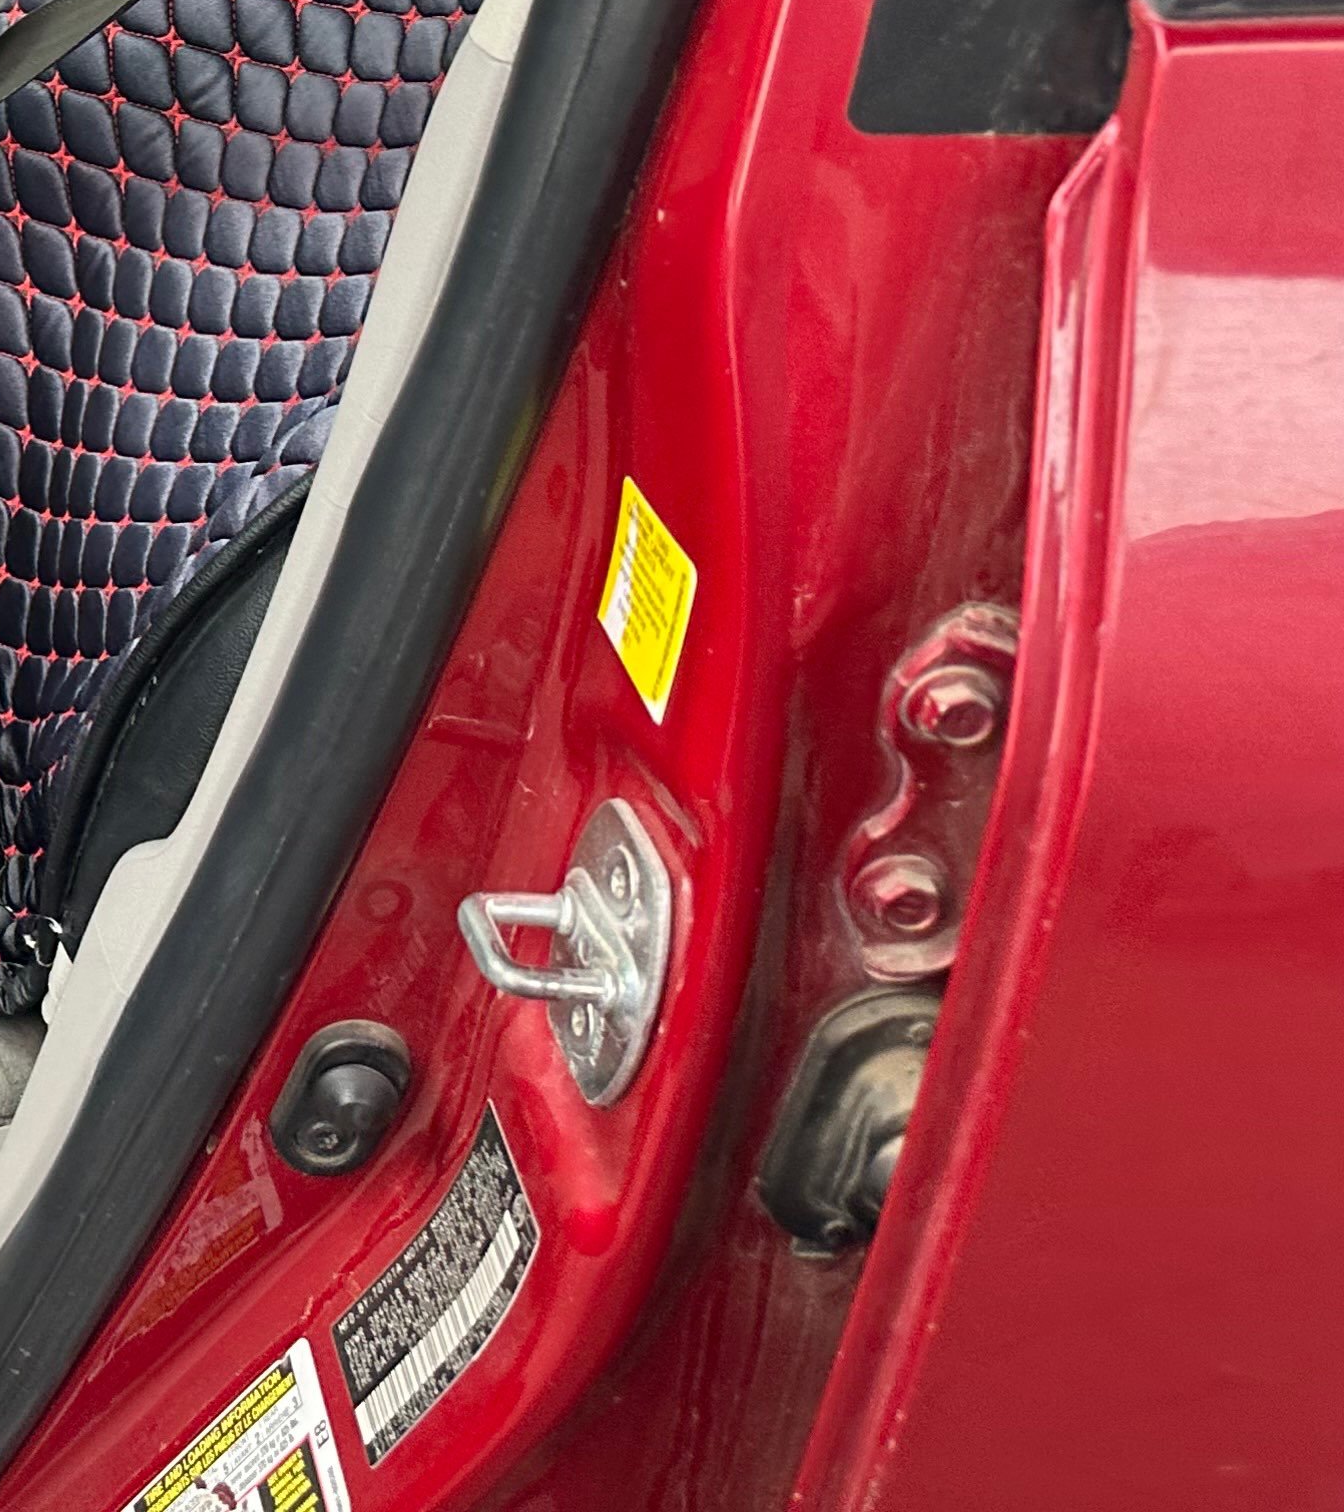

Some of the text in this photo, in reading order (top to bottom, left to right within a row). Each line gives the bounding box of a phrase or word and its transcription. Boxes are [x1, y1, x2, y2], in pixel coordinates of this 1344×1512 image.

[144, 1480, 164, 1508] TIRE
[163, 1462, 182, 1489] AND
[182, 1425, 220, 1471] LOADING
[220, 1367, 281, 1434] INFORMATION
[314, 1419, 329, 1449] E8
